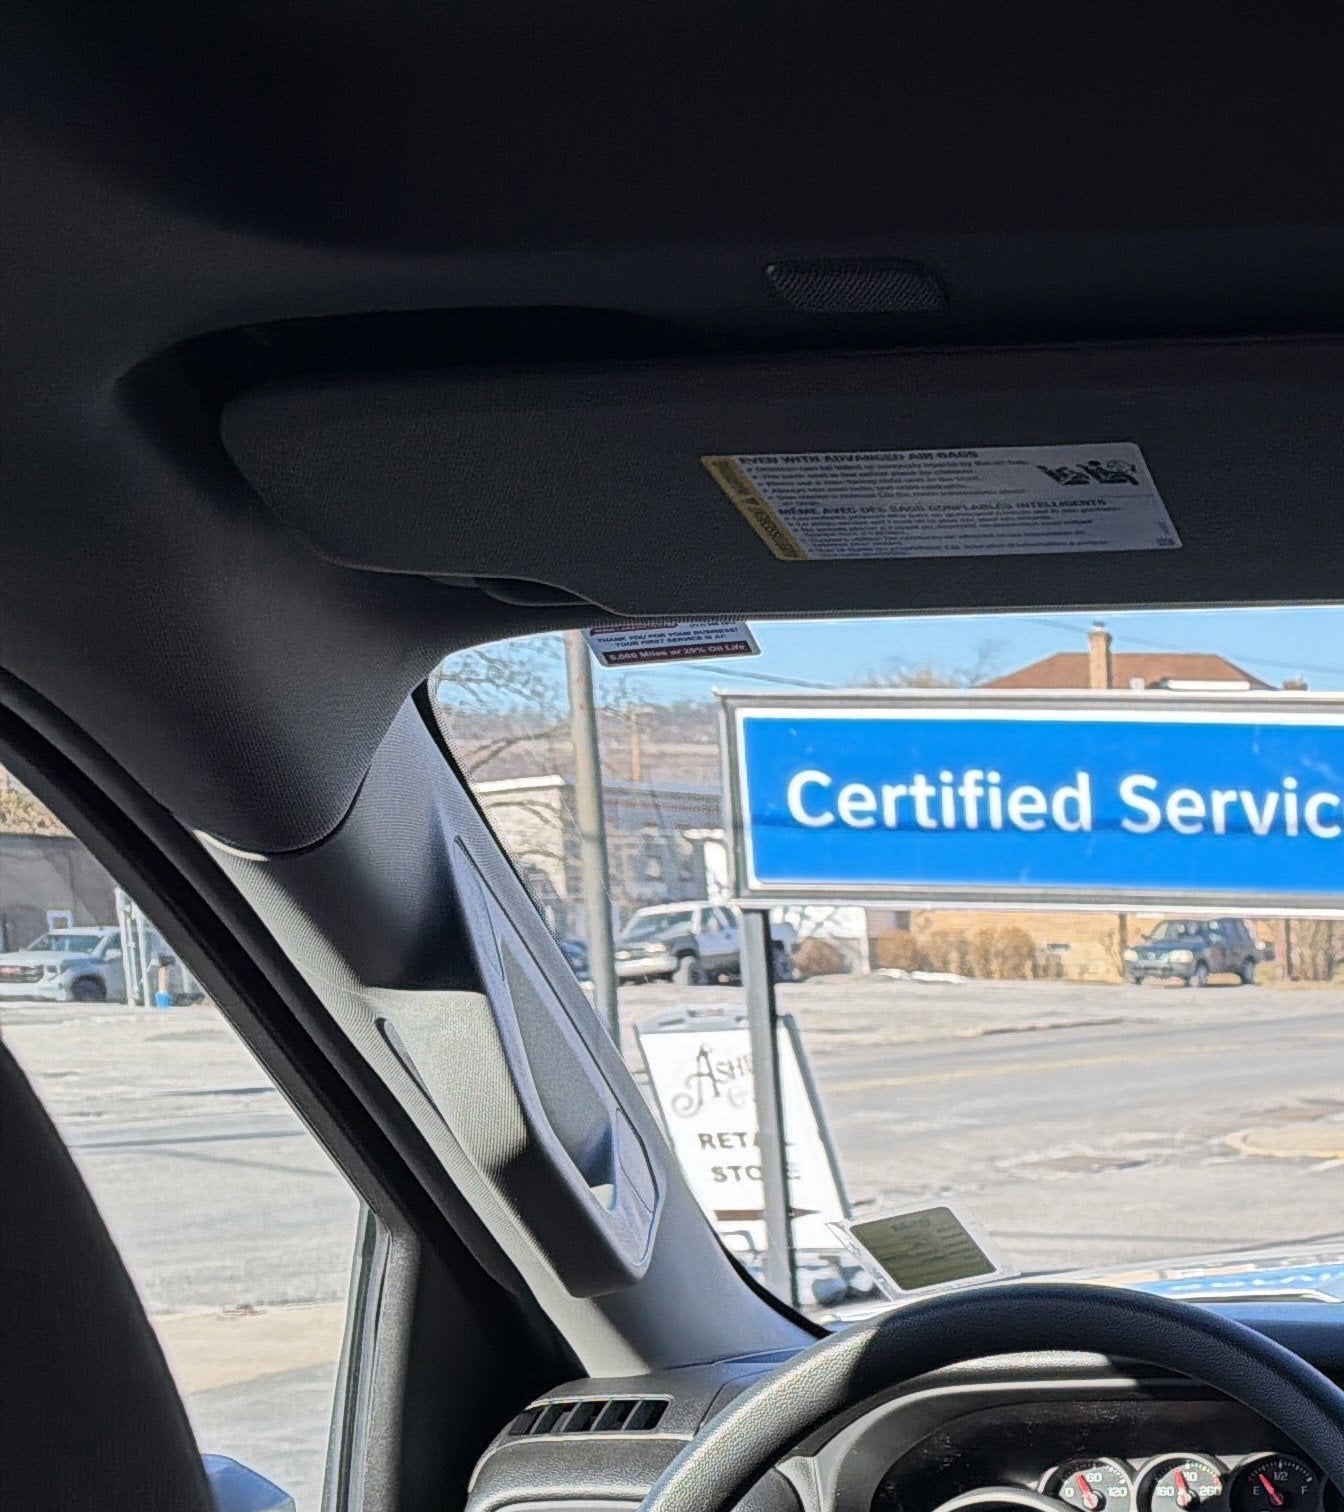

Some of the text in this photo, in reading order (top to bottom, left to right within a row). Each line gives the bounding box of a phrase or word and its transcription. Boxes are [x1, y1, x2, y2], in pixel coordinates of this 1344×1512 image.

[786, 769, 1091, 832] Certified
[1106, 1487, 1128, 1497] 120
[1199, 1486, 1221, 1497] 260
[1252, 1485, 1261, 1496] E
[1301, 1485, 1309, 1495] F
